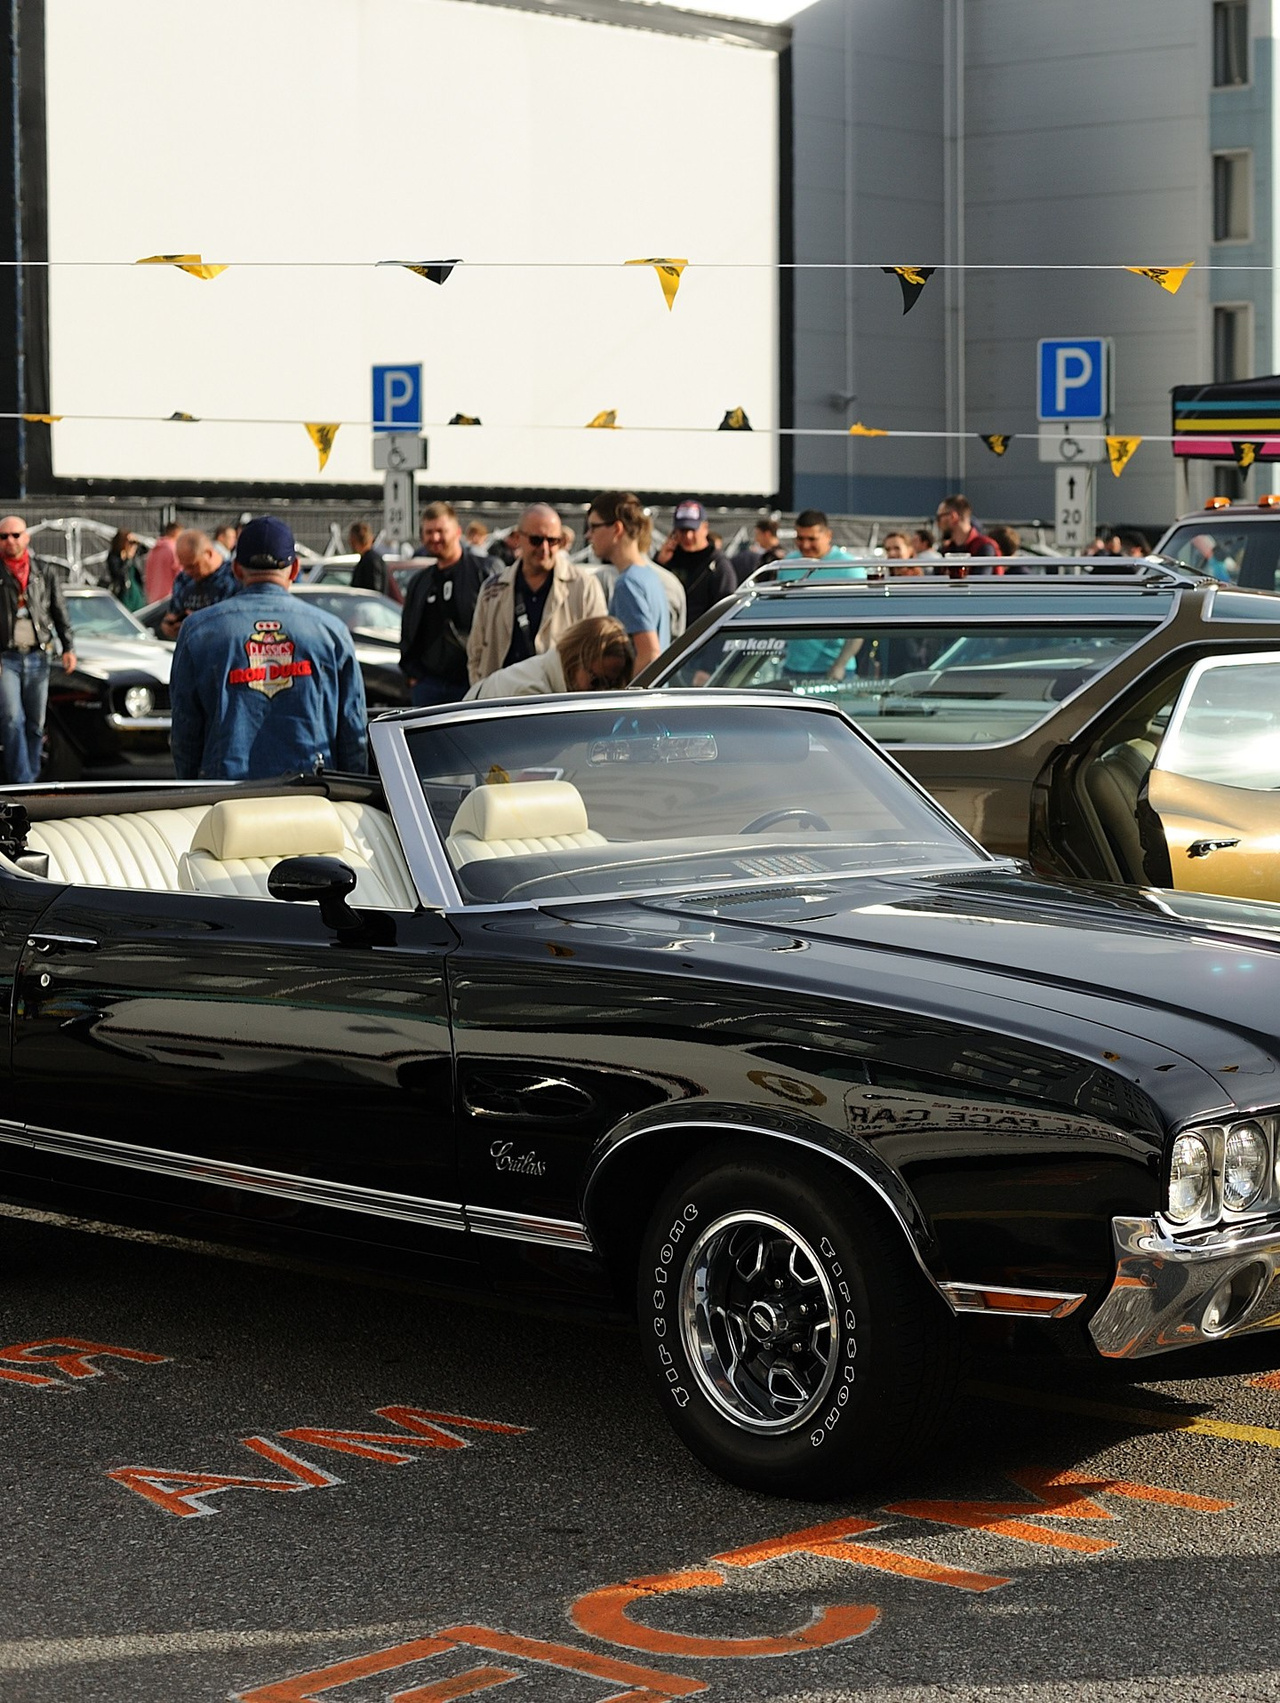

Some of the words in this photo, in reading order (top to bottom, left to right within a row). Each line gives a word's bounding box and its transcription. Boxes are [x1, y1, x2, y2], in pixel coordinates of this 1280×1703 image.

[383, 370, 414, 425] P
[1055, 347, 1093, 412] P
[1061, 509, 1082, 525] 20
[249, 641, 291, 655] CLASSICS
[490, 1140, 547, 1176] Cutlass
